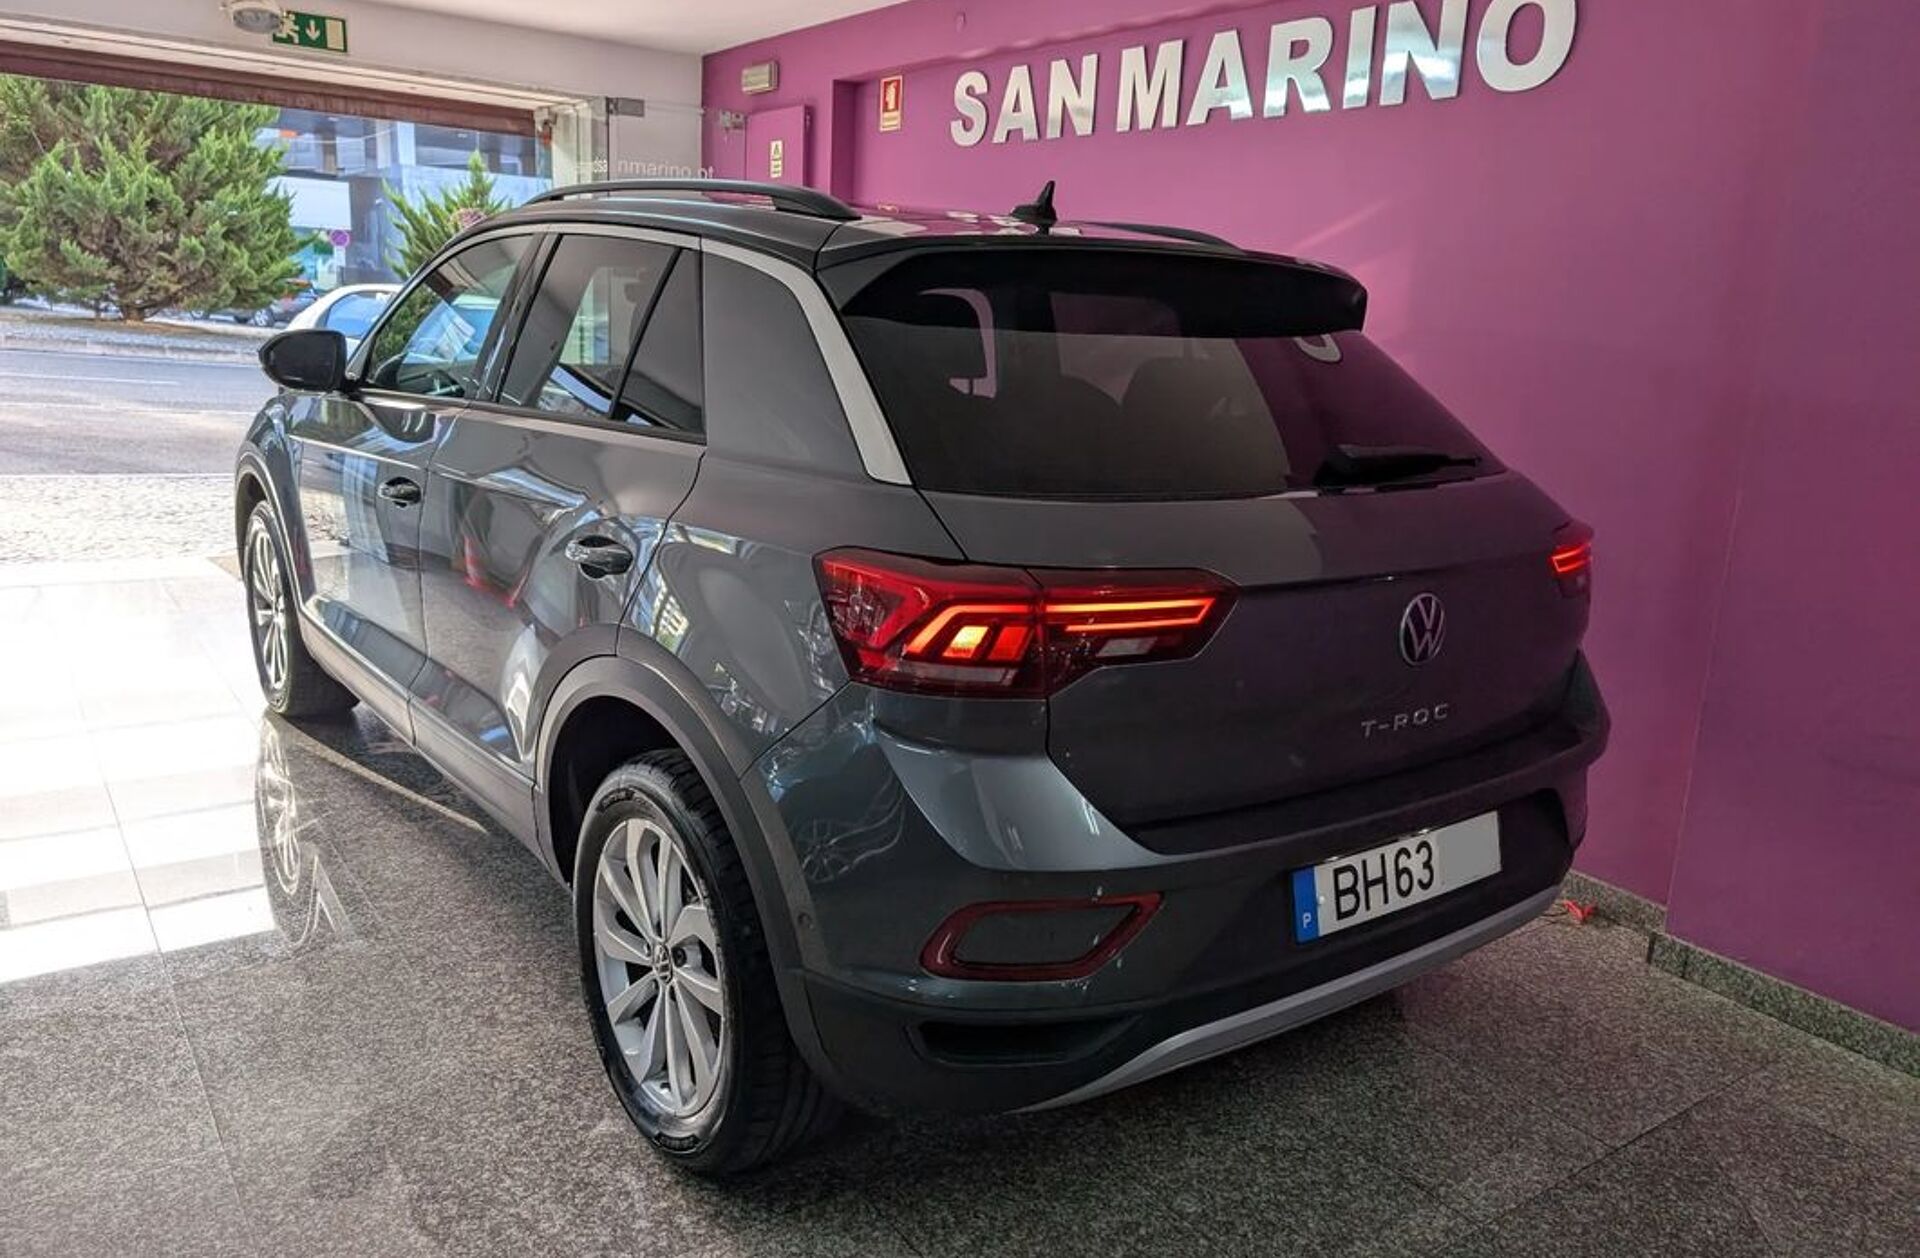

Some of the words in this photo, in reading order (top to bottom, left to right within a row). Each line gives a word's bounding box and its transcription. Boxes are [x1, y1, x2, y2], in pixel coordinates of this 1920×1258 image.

[950, 54, 1099, 147] SAN
[1116, 0, 1578, 133] MARINO
[1360, 703, 1449, 739] T-ROC
[1302, 911, 1313, 929] P
